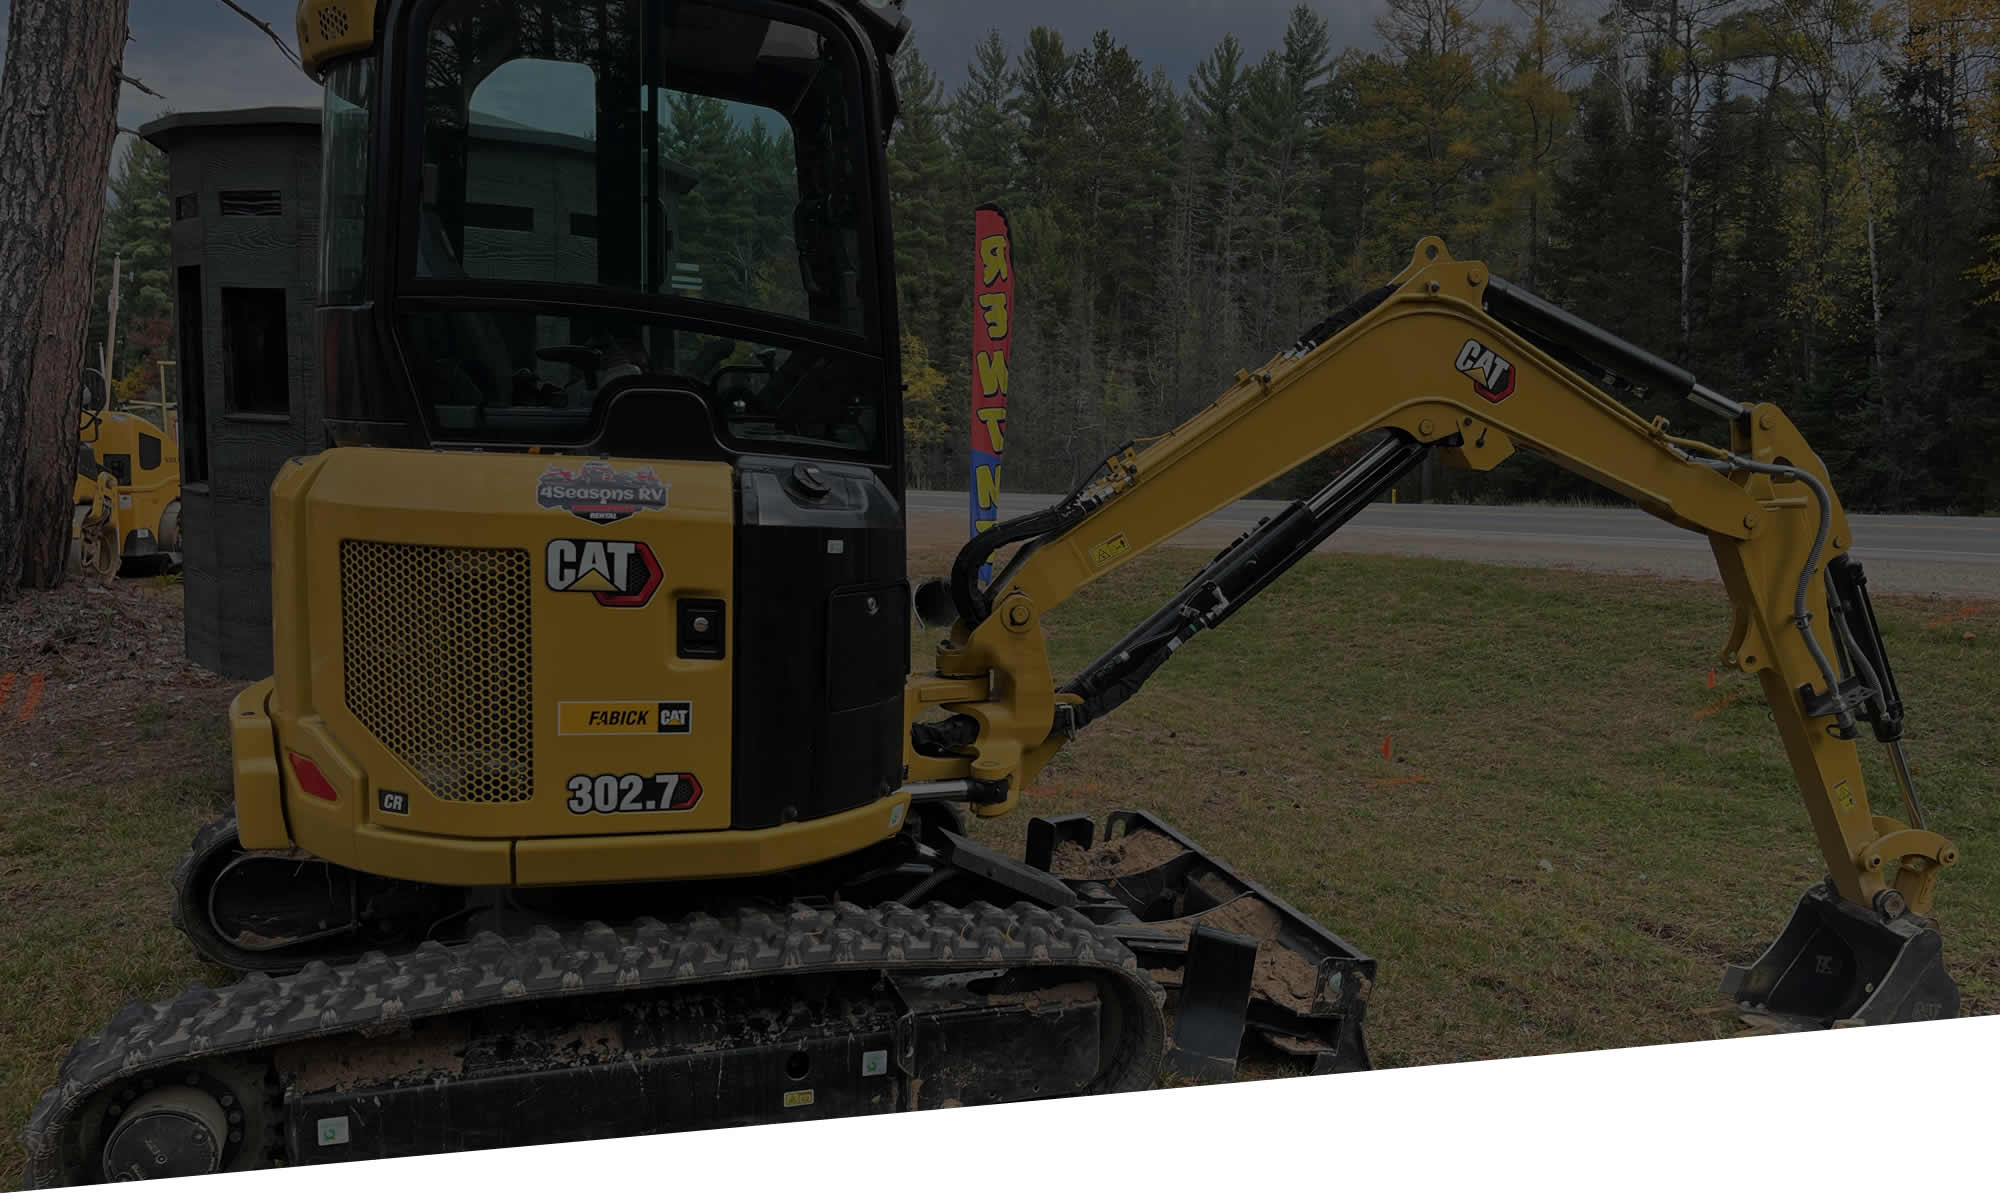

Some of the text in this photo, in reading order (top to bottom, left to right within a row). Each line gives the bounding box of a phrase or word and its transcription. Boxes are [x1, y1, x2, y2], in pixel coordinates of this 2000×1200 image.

[1455, 340, 1511, 391] CAT
[540, 485, 665, 504] 4Seasons RV
[547, 539, 636, 592] CAT
[589, 709, 689, 727] FABICK CAT
[383, 793, 403, 811] CR
[567, 773, 681, 813] 302.7
